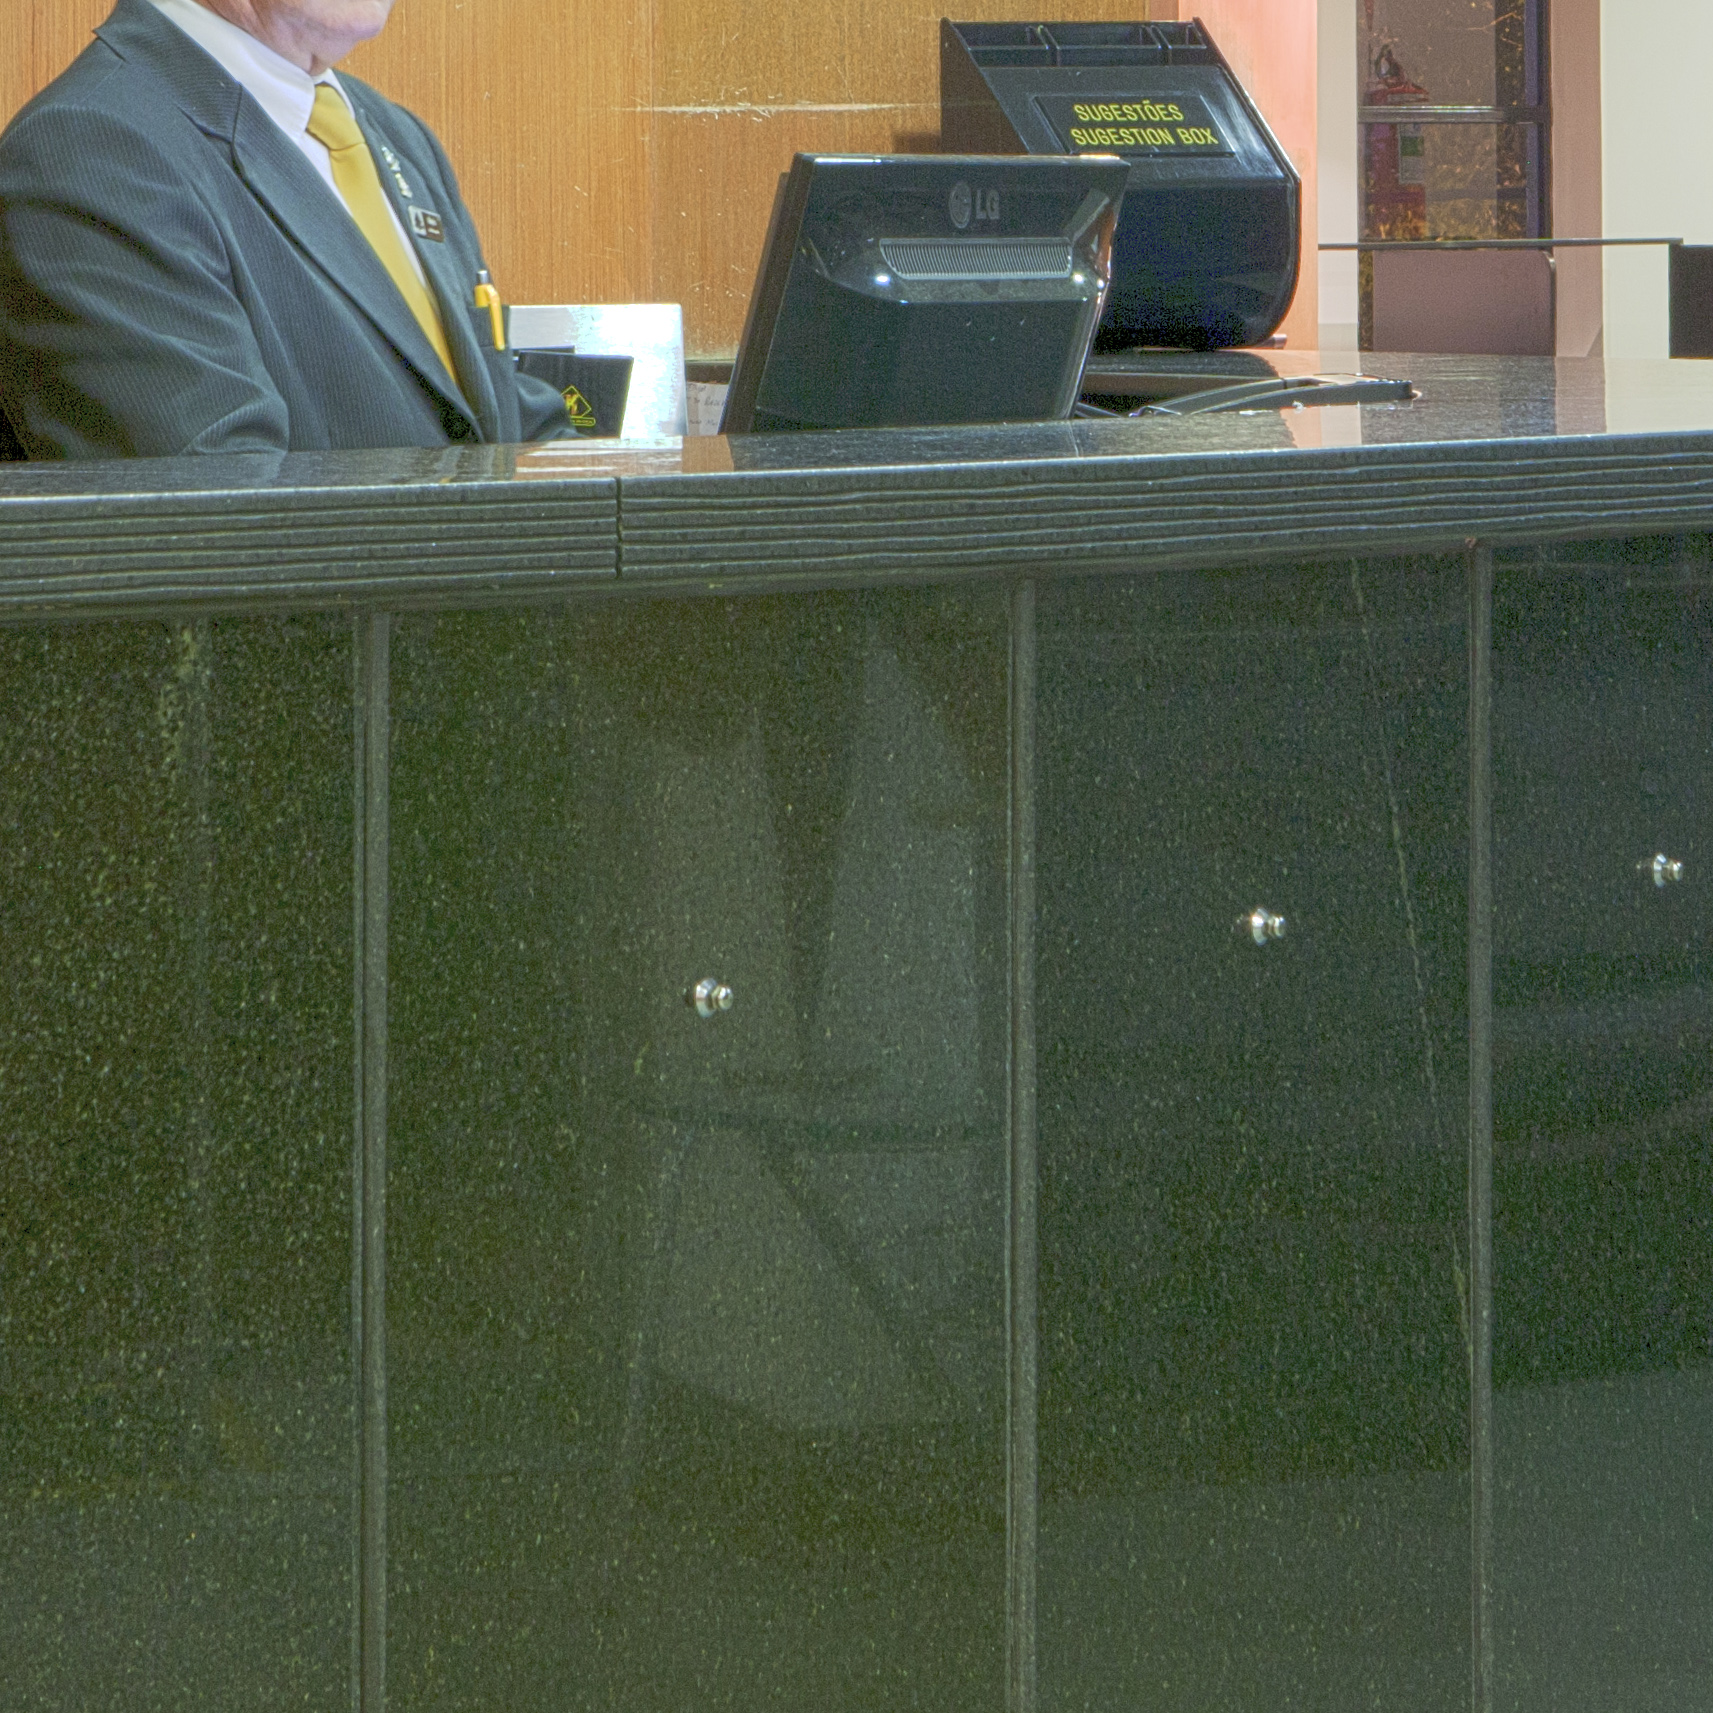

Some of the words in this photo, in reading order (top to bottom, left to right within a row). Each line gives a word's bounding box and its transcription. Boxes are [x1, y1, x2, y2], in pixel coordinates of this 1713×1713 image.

[1073, 99, 1184, 122] SUGESTÕES
[1070, 127, 1175, 145] SUGESTION
[1176, 127, 1219, 145] BOX
[975, 188, 1000, 220] LG
